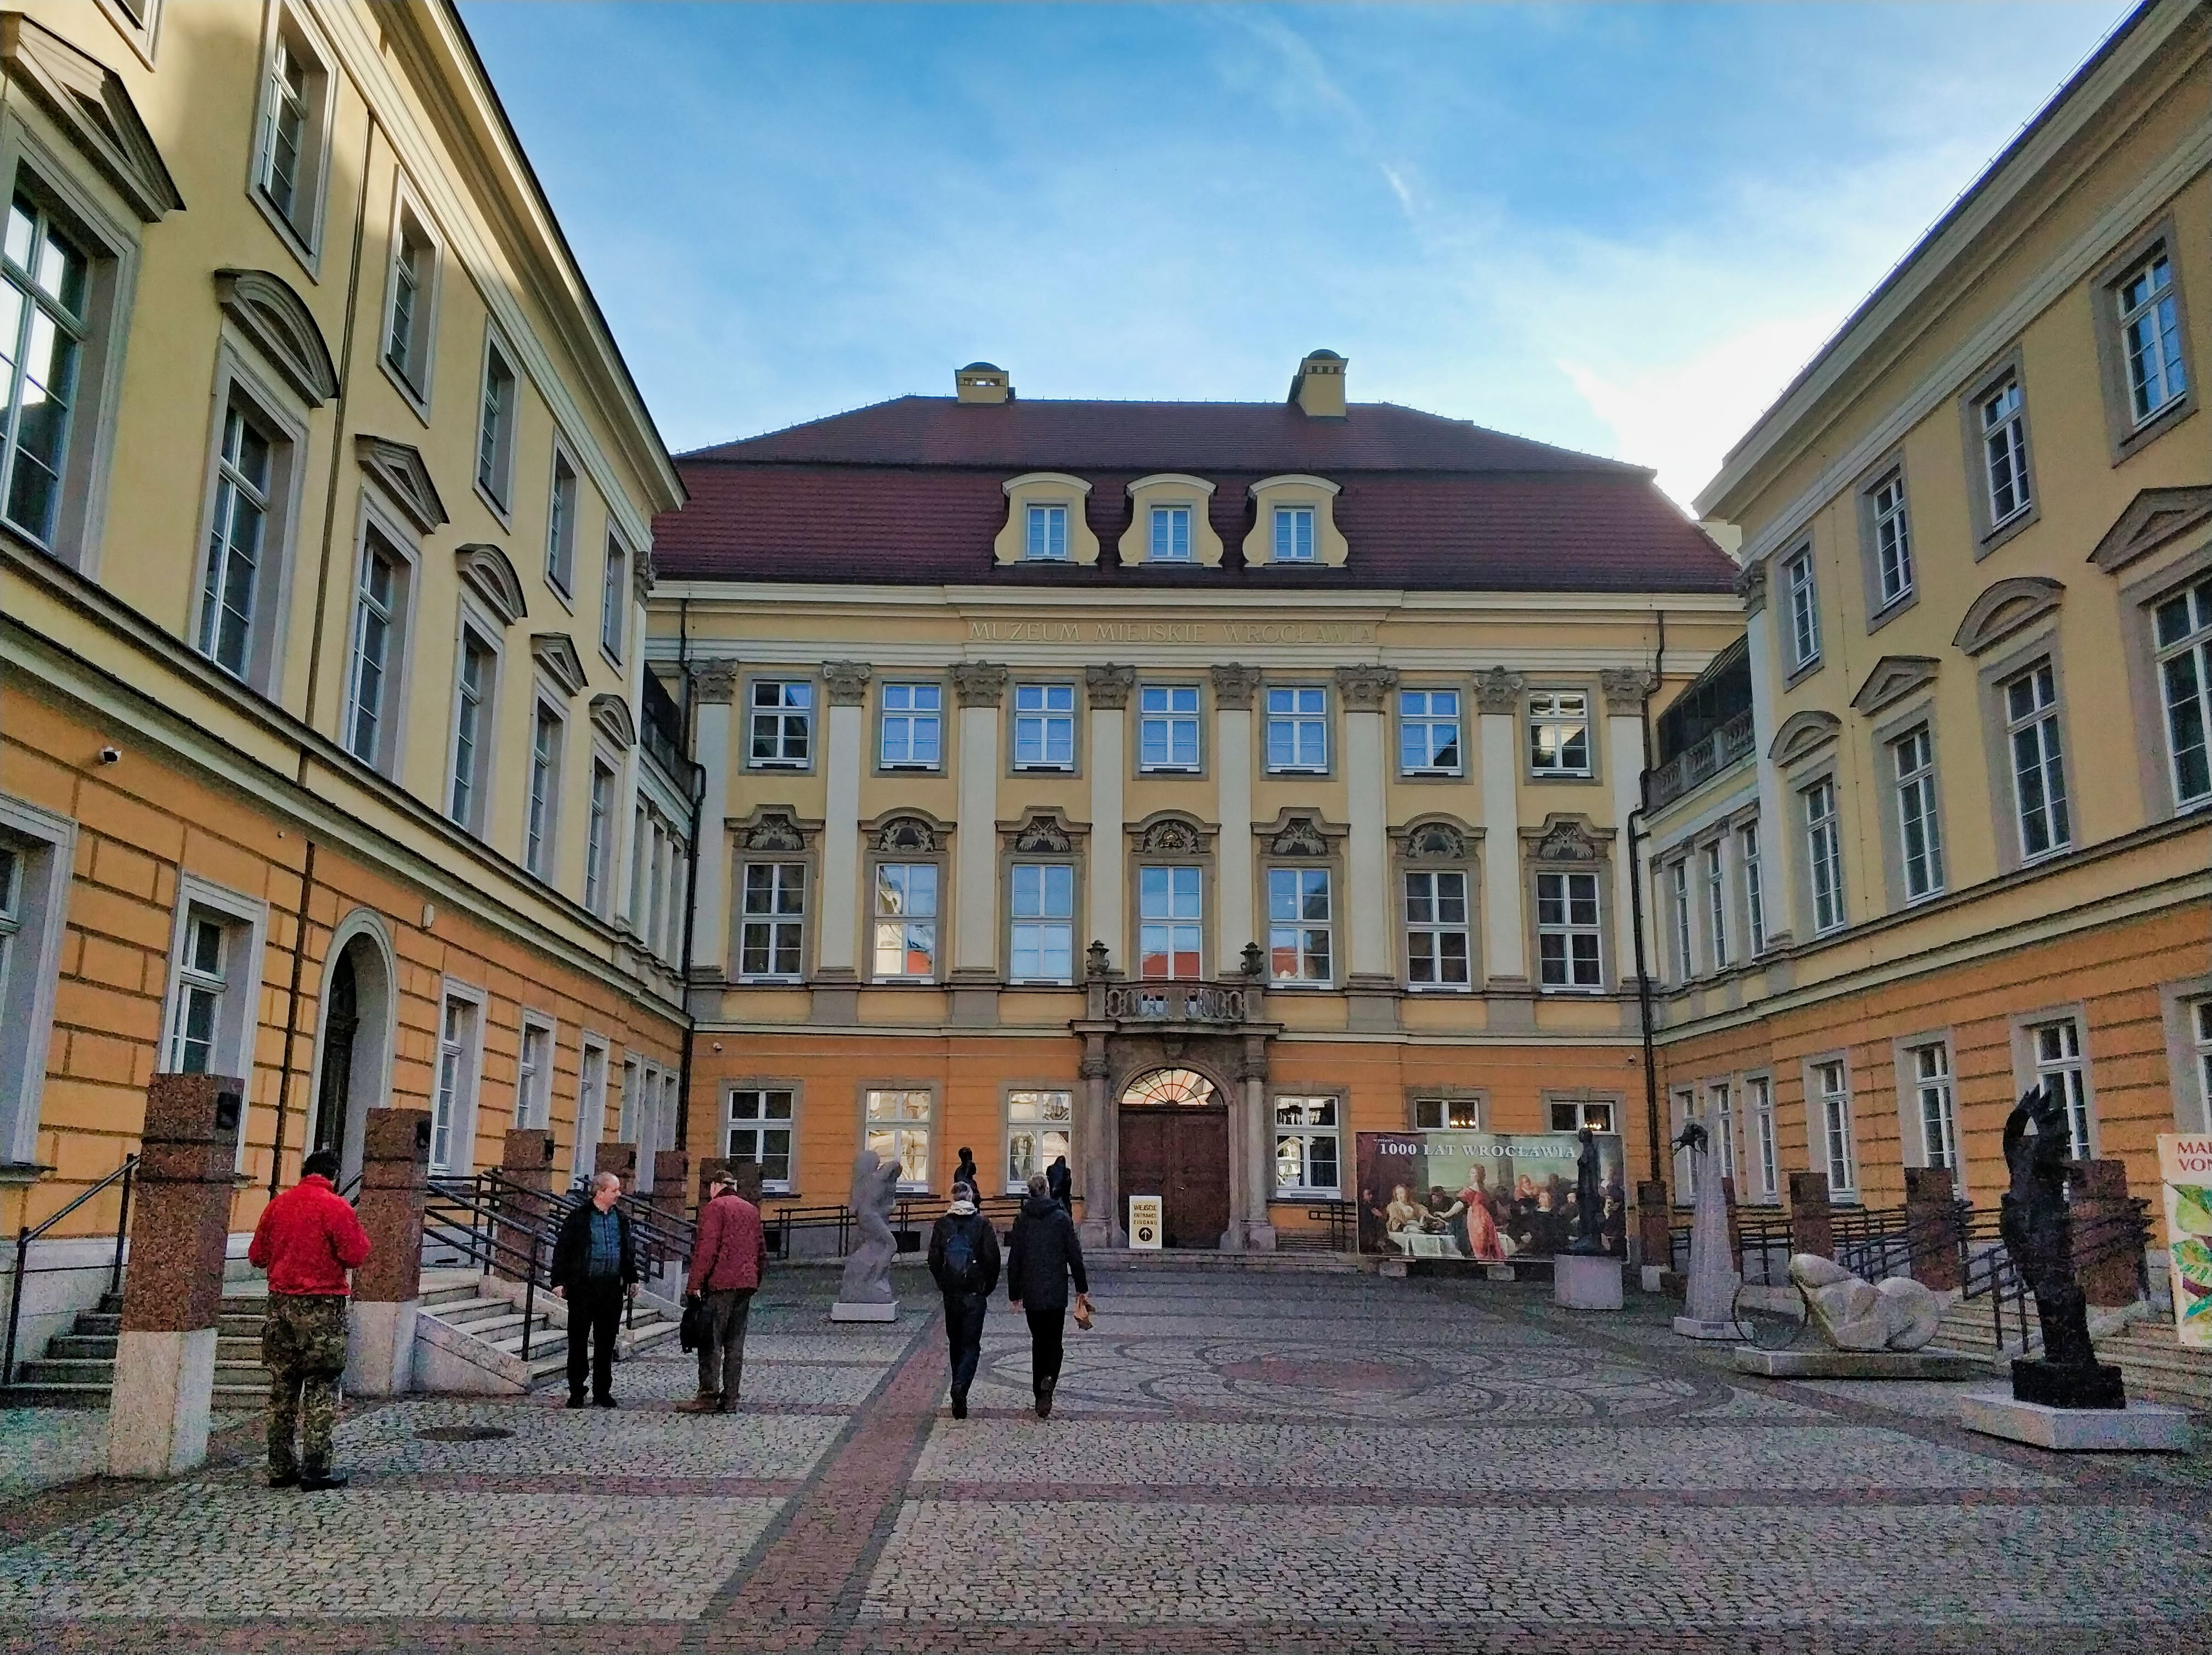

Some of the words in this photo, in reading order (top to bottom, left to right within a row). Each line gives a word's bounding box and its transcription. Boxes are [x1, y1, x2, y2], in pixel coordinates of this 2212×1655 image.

[969, 622, 1081, 641] MUZEUM
[1094, 623, 1206, 643] MIEJSKIE
[1222, 624, 1374, 644] WROCŁAWIA
[1380, 1144, 1417, 1155] 1000
[1423, 1144, 1456, 1156] LAT
[1462, 1145, 1577, 1158] WROCŁAWIA
